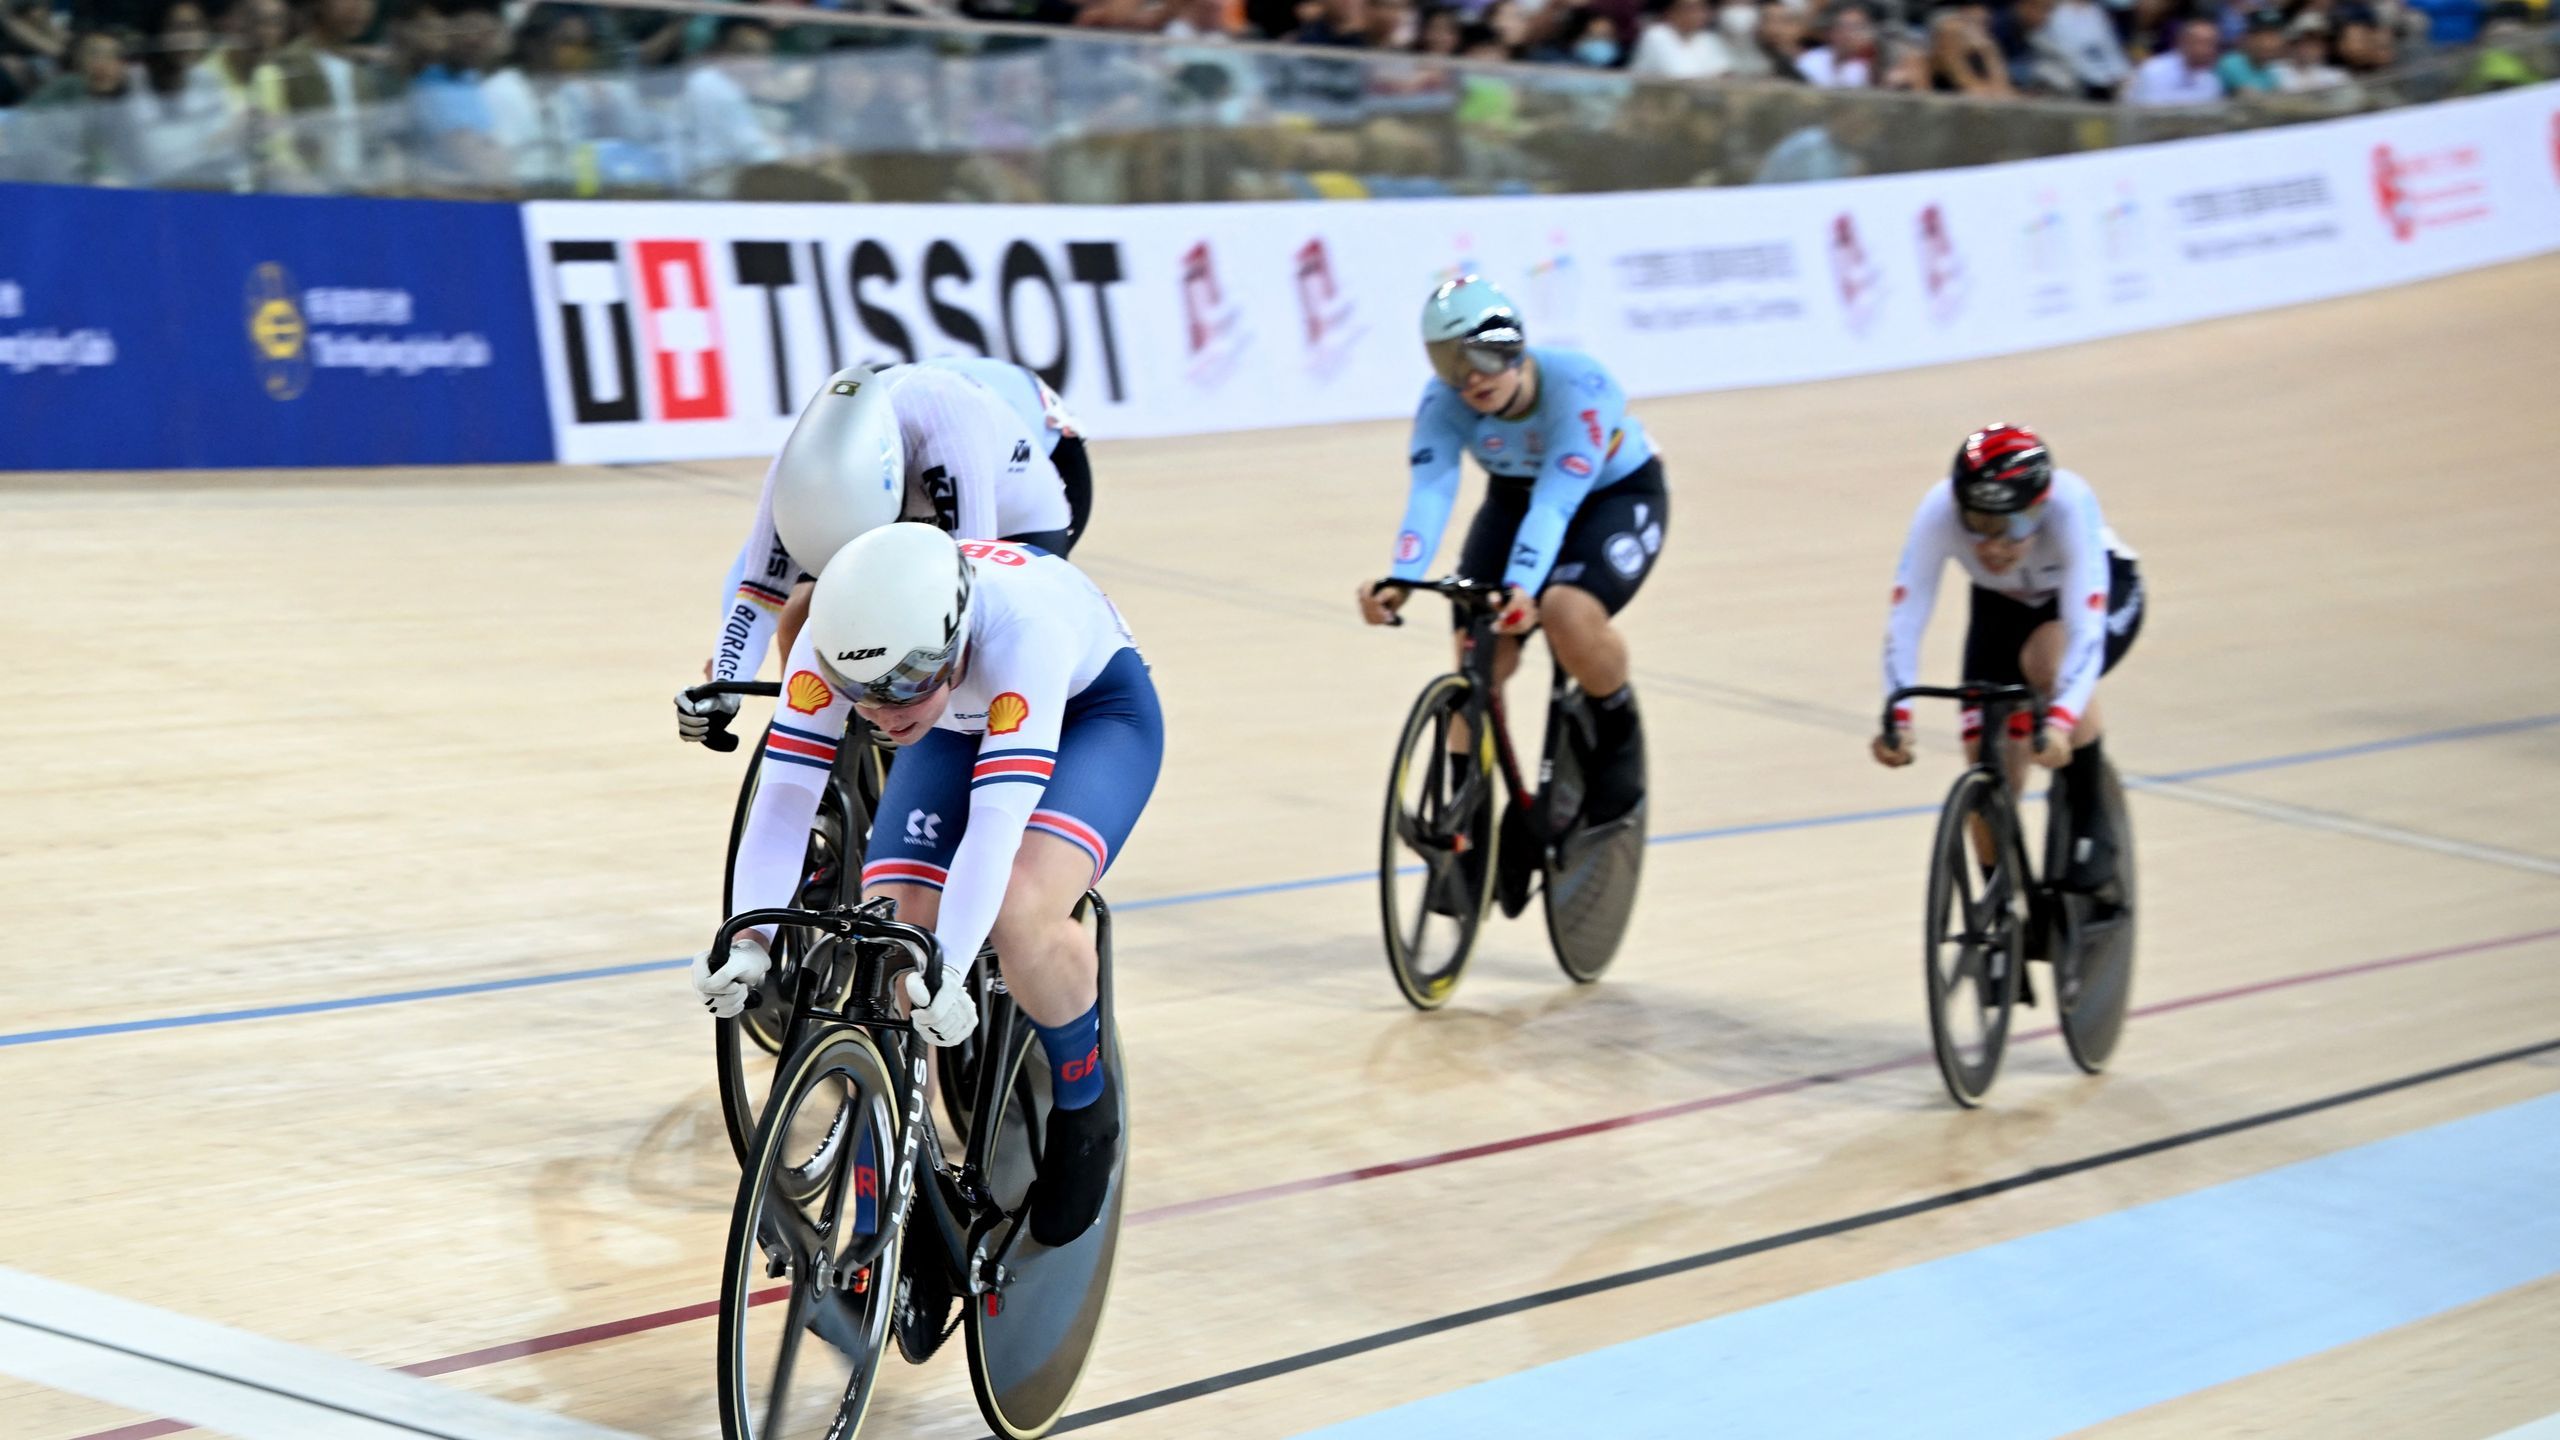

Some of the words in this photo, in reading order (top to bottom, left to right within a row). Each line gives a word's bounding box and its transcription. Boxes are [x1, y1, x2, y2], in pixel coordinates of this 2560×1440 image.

[731, 239, 1127, 417] TISSOT
[717, 604, 757, 683] BIORACE
[837, 646, 887, 661] LAZER
[891, 1057, 927, 1226] LOTUS
